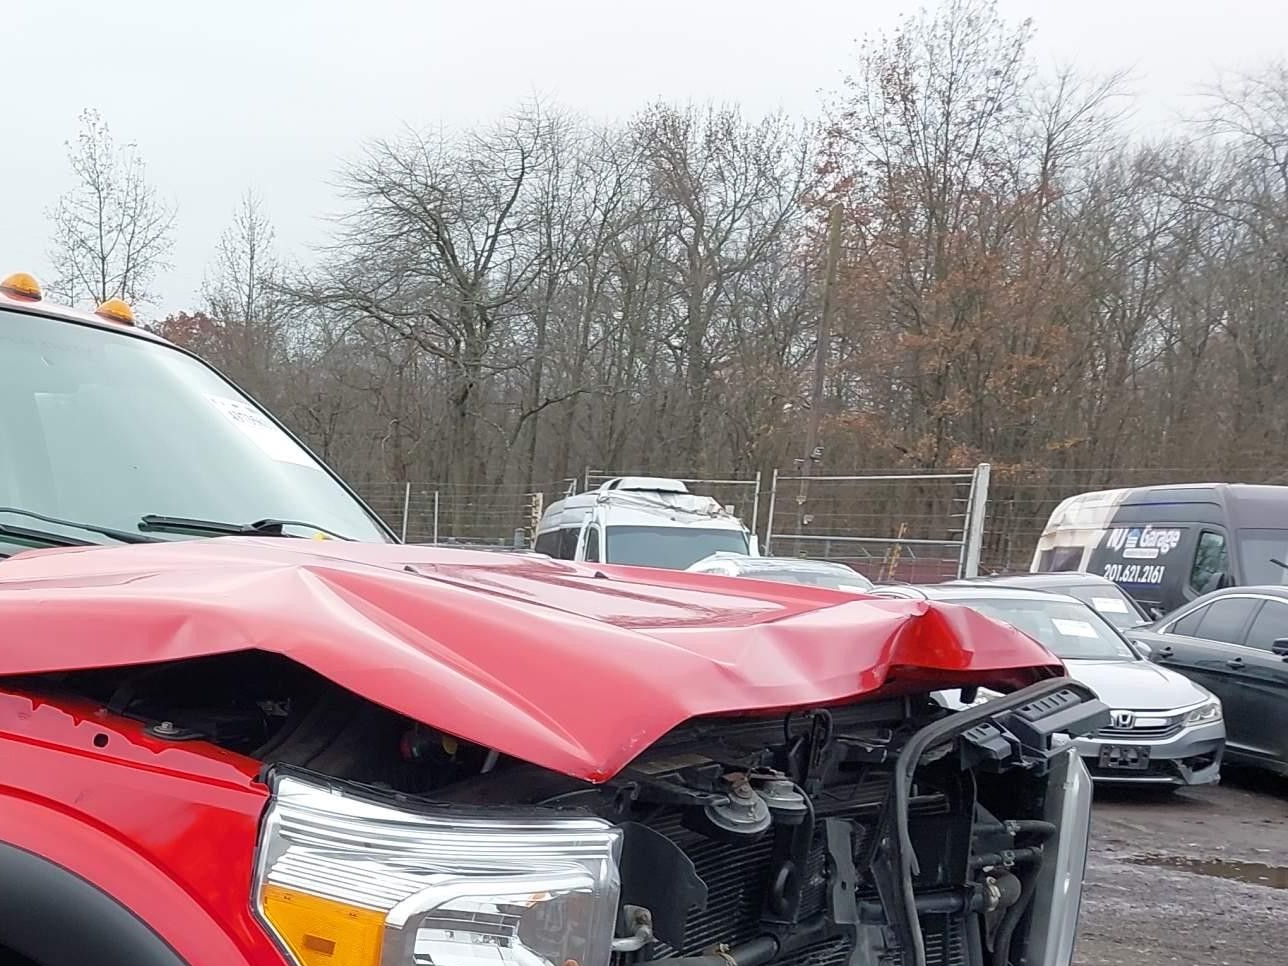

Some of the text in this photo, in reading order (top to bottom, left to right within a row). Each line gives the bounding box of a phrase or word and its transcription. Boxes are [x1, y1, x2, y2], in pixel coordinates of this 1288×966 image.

[1107, 525, 1181, 554] NJ Garage
[1104, 564, 1165, 583] 201.621.2161
